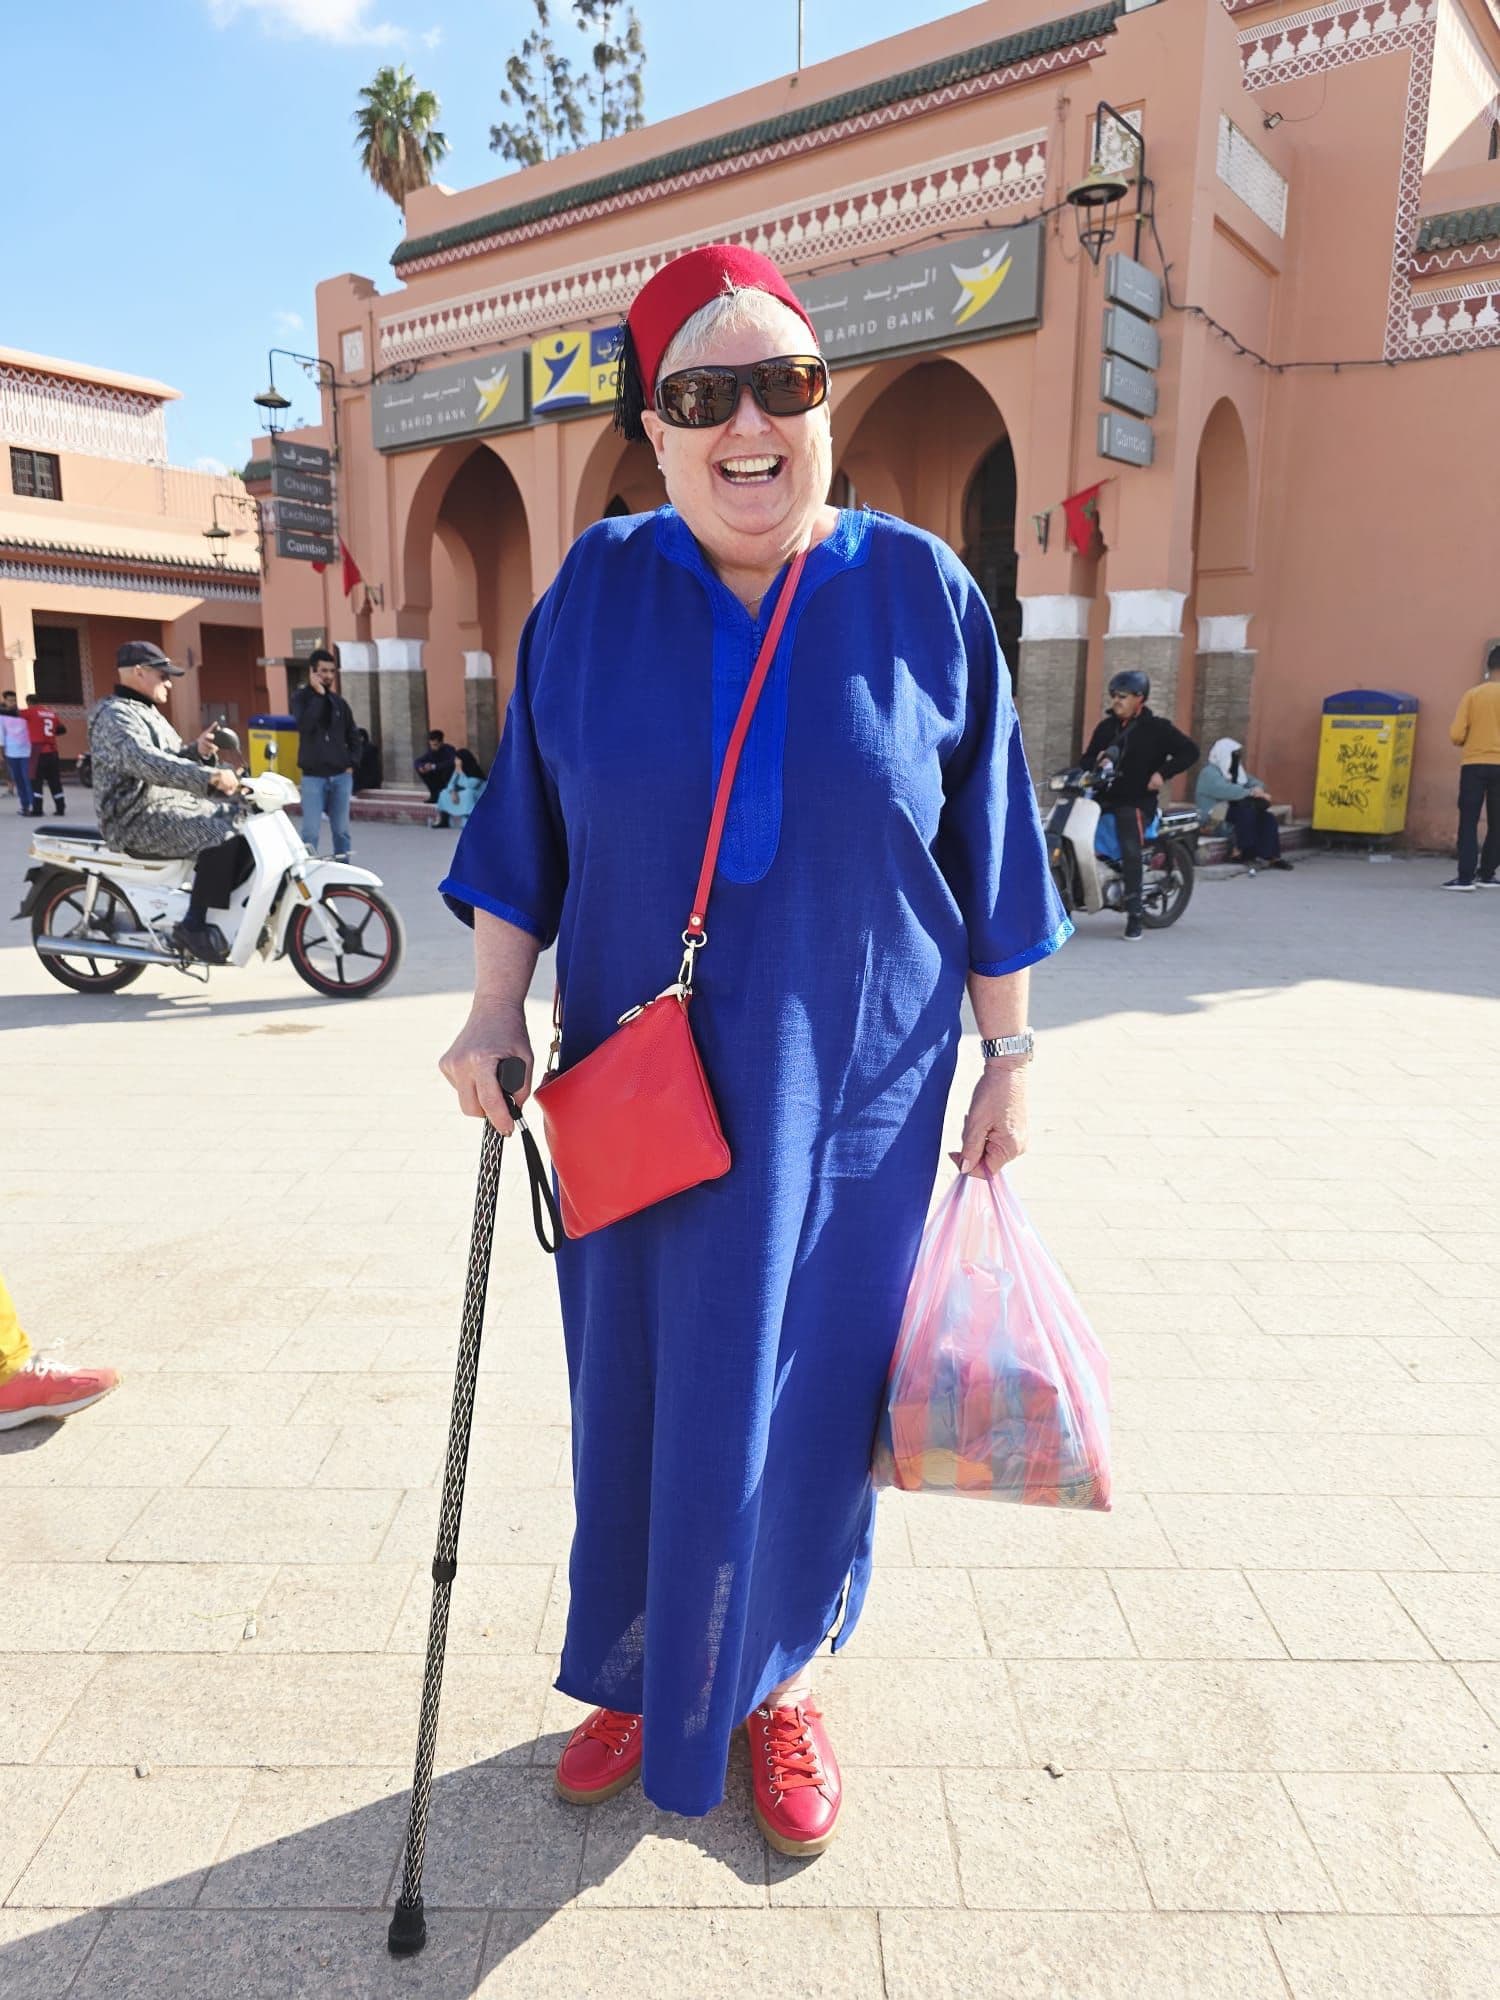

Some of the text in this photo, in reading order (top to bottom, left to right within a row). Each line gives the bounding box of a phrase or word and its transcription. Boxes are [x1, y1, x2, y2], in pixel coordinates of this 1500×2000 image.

[824, 307, 936, 344] BARID BANK
[400, 415, 433, 432] BARID
[438, 408, 466, 427] BANK
[285, 477, 324, 495] Change
[286, 539, 327, 555] Cambio
[43, 718, 54, 737] 2
